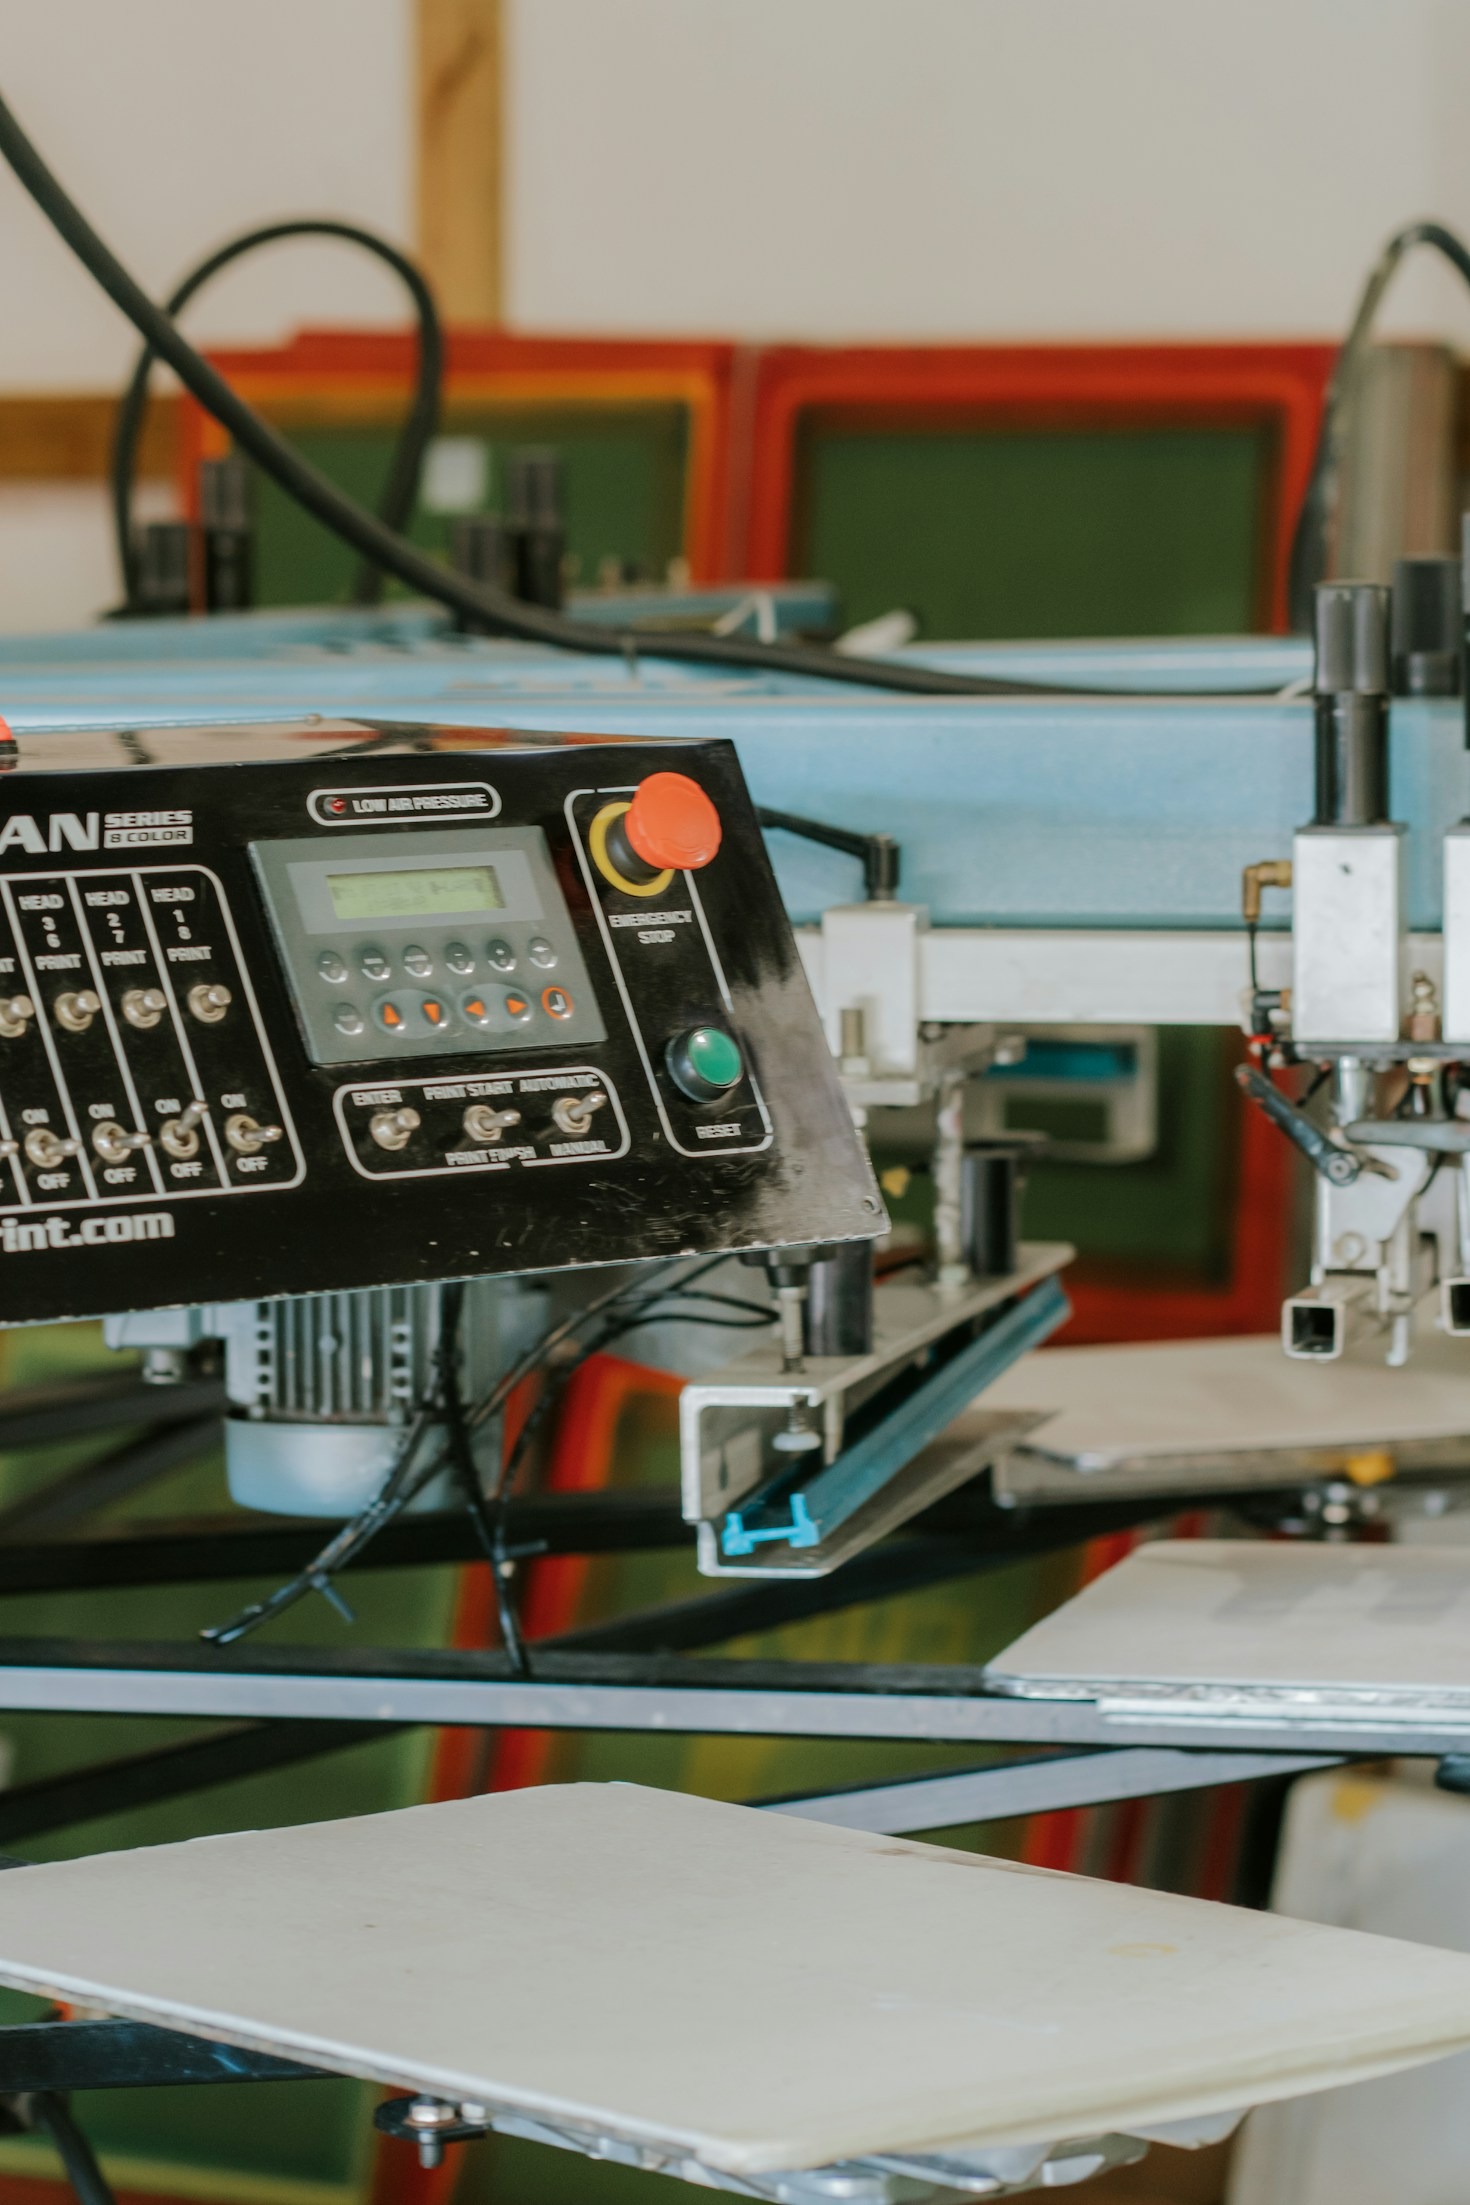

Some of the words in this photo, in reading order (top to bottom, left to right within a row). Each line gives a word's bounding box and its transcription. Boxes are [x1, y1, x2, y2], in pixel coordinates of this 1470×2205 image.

[352, 799, 387, 813] LOW
[389, 797, 414, 811] AIR
[413, 794, 489, 810] PRESSURE
[104, 810, 193, 828] SERIES
[110, 833, 121, 843] 8
[127, 830, 188, 842] COLOR
[18, 894, 64, 910] HEAD
[85, 890, 130, 906] HEAD
[151, 887, 195, 902] HEAD
[42, 916, 56, 931] 3
[107, 913, 122, 927] 2
[172, 909, 185, 923] 1
[608, 910, 692, 928] EMERGENCY
[46, 933, 61, 948] 6
[112, 929, 125, 943] 7
[177, 926, 192, 940] 8
[637, 929, 676, 944] STOP
[34, 953, 81, 970] PRINT
[101, 950, 146, 966] PRINT
[166, 946, 212, 962] PRINT
[423, 1084, 467, 1100] PRINT
[466, 1080, 514, 1098] START
[519, 1074, 600, 1092] AUTOMATIC
[221, 1094, 248, 1108] ON
[351, 1089, 403, 1106] ENTER
[88, 1104, 116, 1119] ON
[155, 1099, 182, 1114] ON
[22, 1108, 50, 1124] ON
[695, 1123, 742, 1139] RESET
[445, 1149, 490, 1166] PRINT
[489, 1146, 537, 1162] FINISH
[549, 1140, 612, 1157] MANUAL
[170, 1162, 202, 1178] OFF
[236, 1156, 269, 1172] OFF
[37, 1172, 70, 1190] OFF
[103, 1167, 137, 1184] OFF
[0, 1212, 175, 1252] int.com
